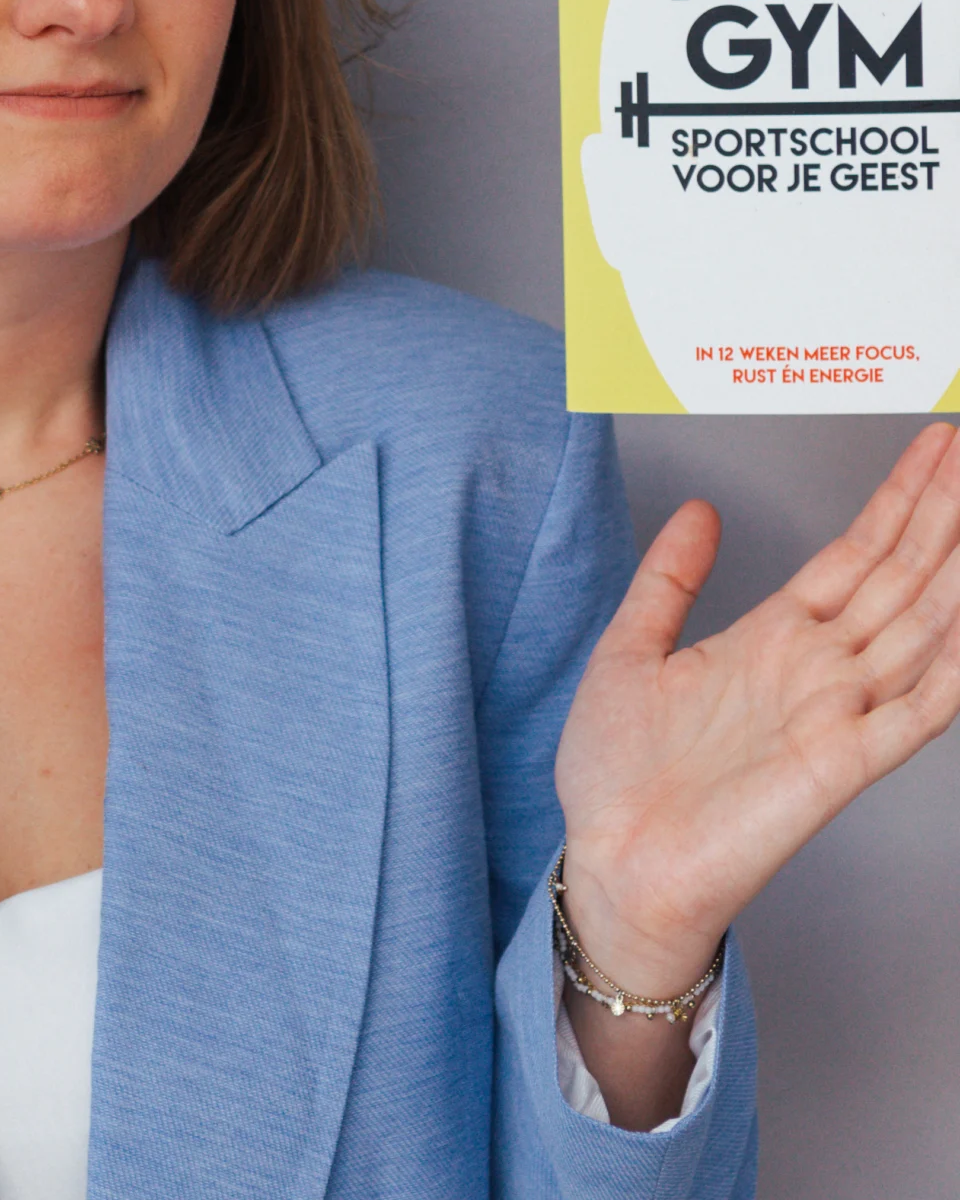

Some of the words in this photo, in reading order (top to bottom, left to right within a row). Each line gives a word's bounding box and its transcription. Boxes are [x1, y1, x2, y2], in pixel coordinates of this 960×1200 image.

[685, 2, 924, 91] GYM
[671, 125, 940, 157] SPORTSCHOOL
[672, 164, 778, 193] VOOR
[786, 163, 821, 192] JE
[830, 161, 941, 191] GEEST
[695, 346, 714, 361] IN
[718, 346, 735, 361] 12
[739, 346, 800, 361] WEKEN
[804, 346, 851, 360] MEER
[855, 345, 921, 362] FOCUS,
[732, 368, 777, 384] RUST
[781, 363, 807, 384] ÉN
[809, 367, 884, 383] ENERGIE
